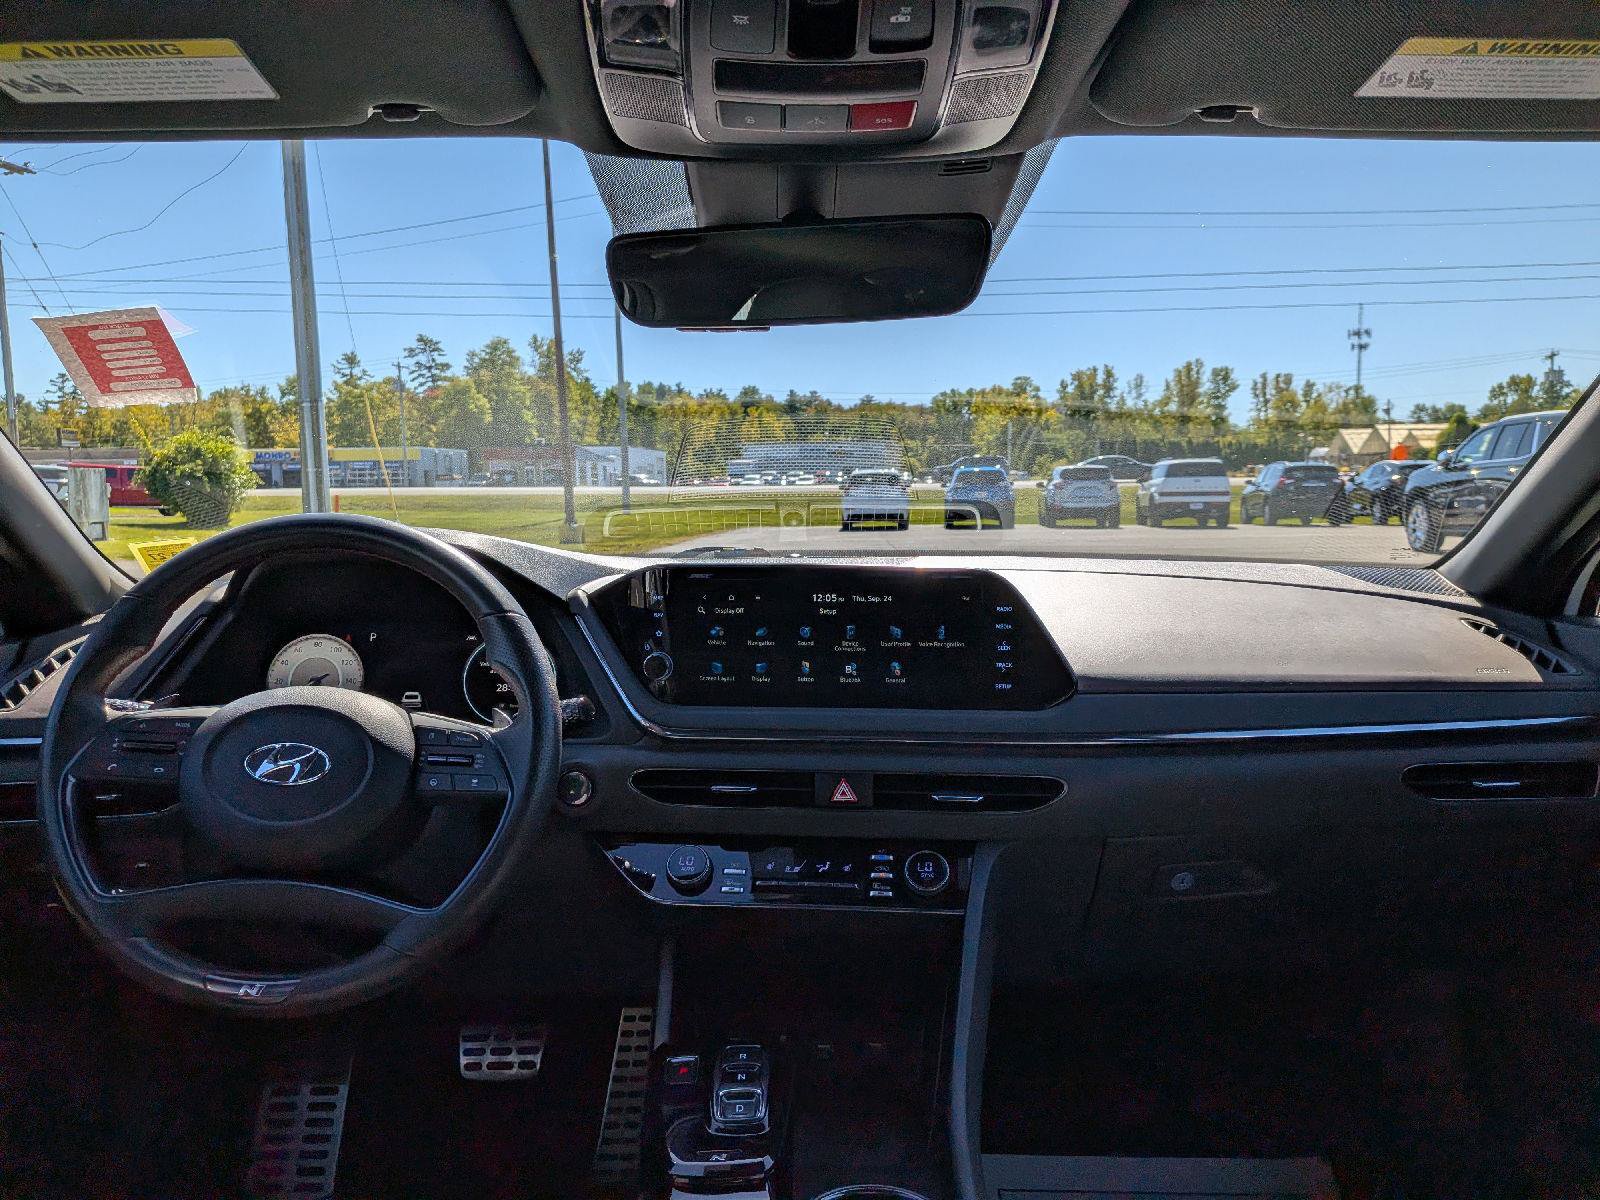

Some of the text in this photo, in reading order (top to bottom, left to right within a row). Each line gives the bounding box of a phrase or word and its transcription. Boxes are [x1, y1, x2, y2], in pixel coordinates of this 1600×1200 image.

[43, 43, 185, 58] WARNING
[1486, 41, 1600, 56] WARNIN
[812, 593, 837, 603] 12:05
[852, 595, 867, 604] Thu,
[883, 595, 893, 603] 24
[714, 607, 735, 615] Display
[819, 607, 838, 616] Setup
[370, 632, 378, 642] P
[747, 639, 776, 647] Navigation
[933, 640, 965, 649] Recognition
[751, 675, 771, 684] Display
[678, 856, 694, 866] LO
[917, 861, 933, 872] LO
[737, 1073, 746, 1081] N
[735, 1104, 744, 1113] D
